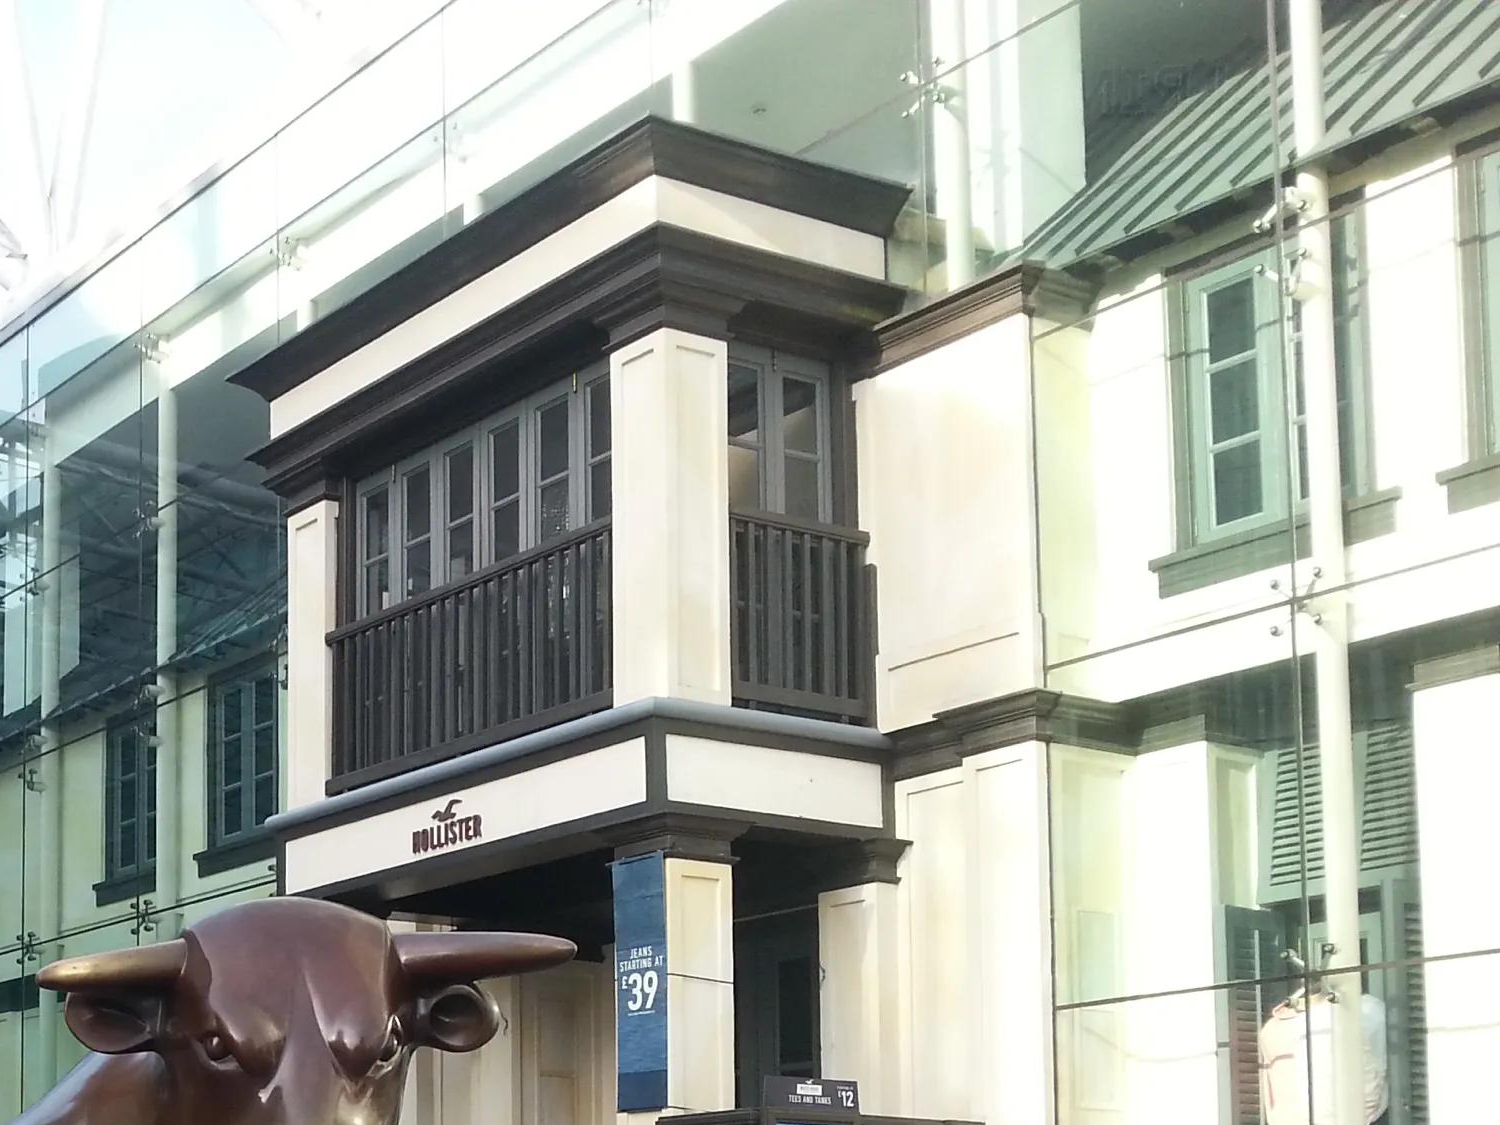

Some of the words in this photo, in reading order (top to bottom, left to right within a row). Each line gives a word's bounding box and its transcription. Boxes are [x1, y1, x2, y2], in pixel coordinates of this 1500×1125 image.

[412, 814, 482, 854] HOLLISTER
[619, 957, 652, 972] STARTING
[654, 955, 664, 967] AT
[630, 946, 653, 959] JEANS
[621, 970, 658, 1011] £39
